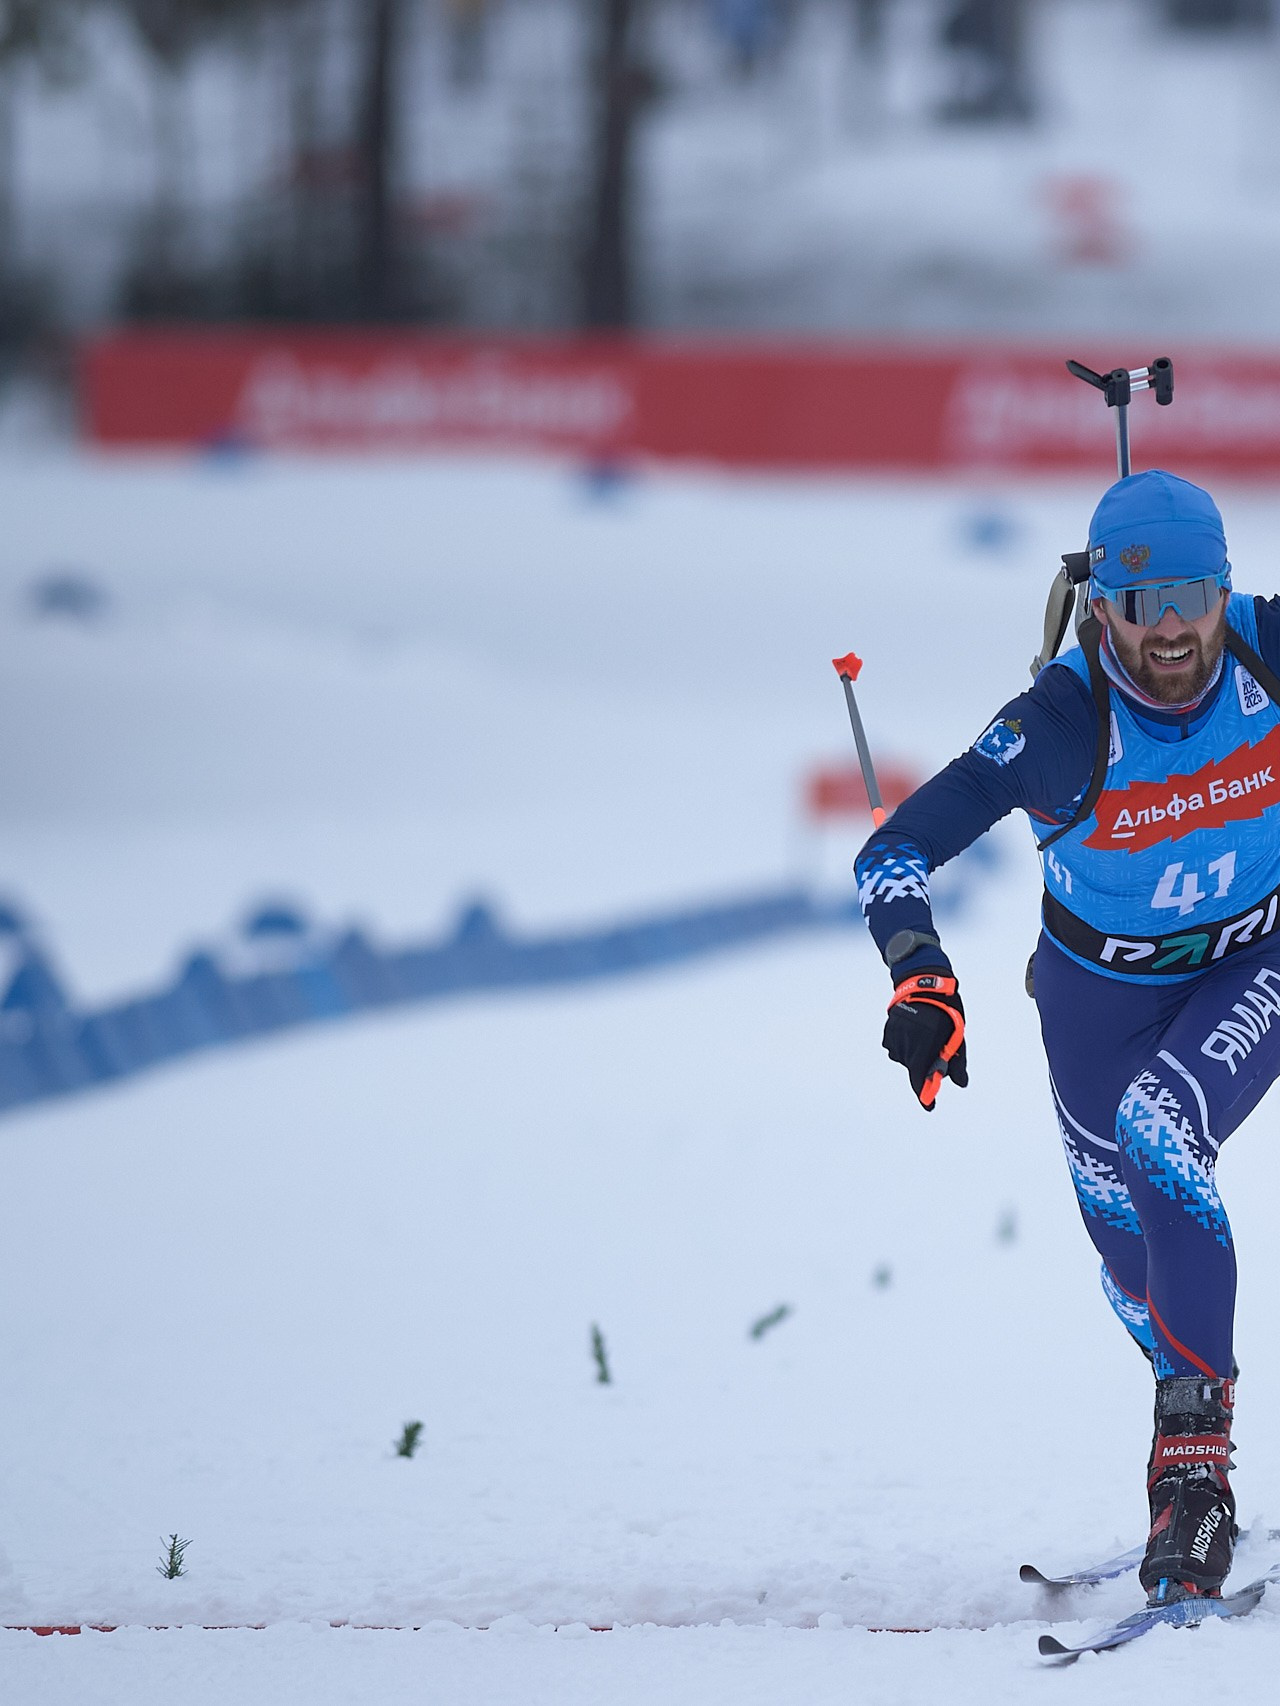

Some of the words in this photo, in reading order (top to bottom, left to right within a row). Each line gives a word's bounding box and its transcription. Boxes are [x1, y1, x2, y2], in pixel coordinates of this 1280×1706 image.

[1111, 790, 1205, 838] Альфа
[1208, 765, 1276, 805] Банк
[1047, 849, 1073, 895] 41
[1150, 850, 1237, 916] 41
[1099, 894, 1279, 970] PARI
[1162, 1445, 1227, 1457] MADSHUS
[1189, 1504, 1223, 1564] MADSHUS
